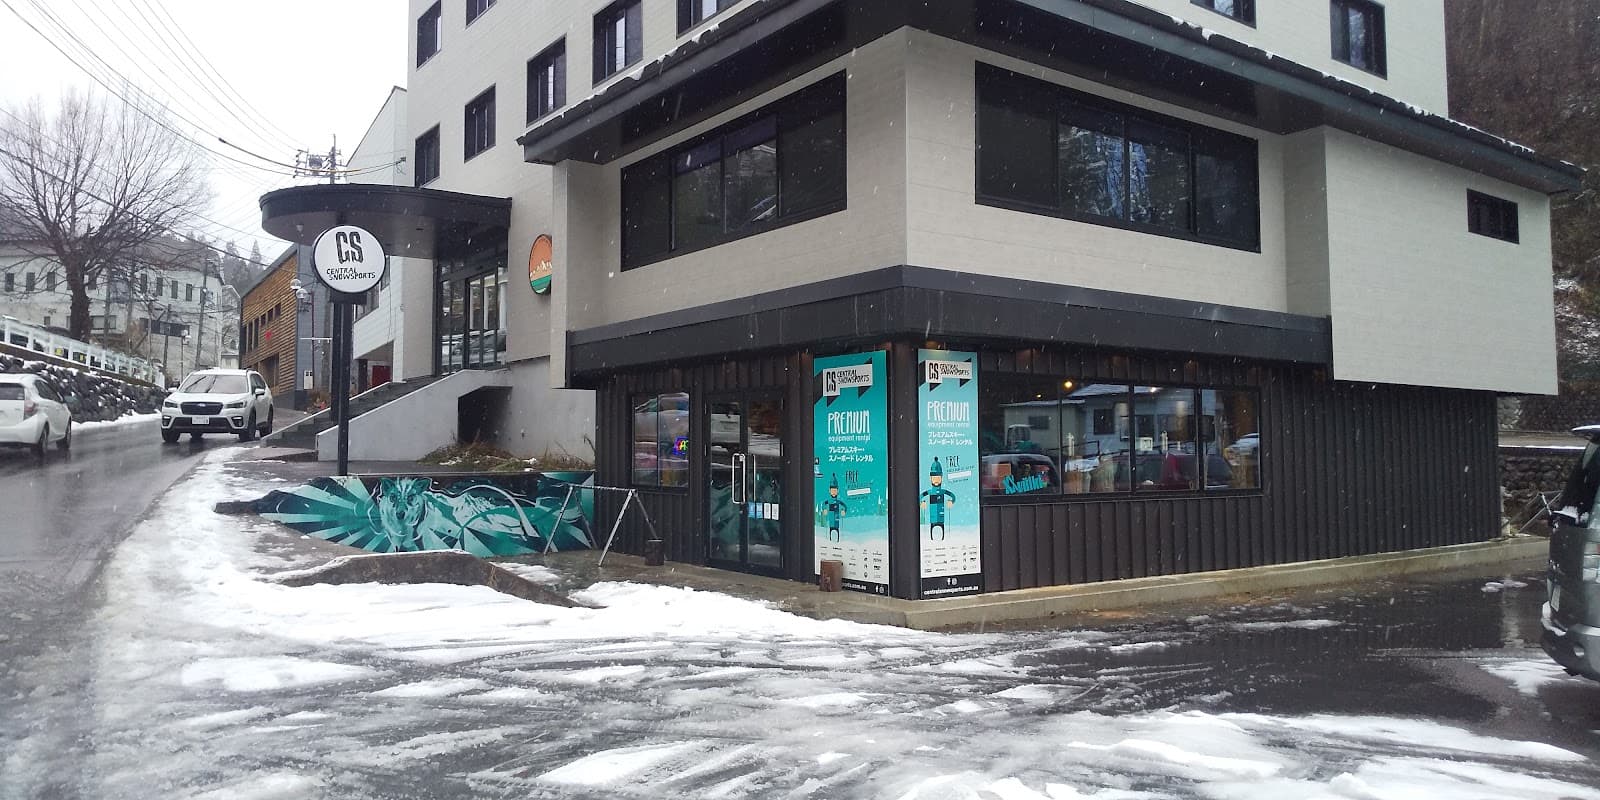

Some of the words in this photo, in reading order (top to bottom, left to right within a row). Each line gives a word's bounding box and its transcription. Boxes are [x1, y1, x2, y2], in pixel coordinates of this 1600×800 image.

[336, 232, 363, 264] CS
[329, 272, 376, 280] SNOWSPORTS
[929, 362, 939, 380] CS
[940, 363, 959, 371] CENTRAL
[940, 367, 970, 376] SNOWSPORTS
[837, 369, 857, 378] CENTRAL
[838, 374, 870, 384] SNOWSPORTS
[826, 371, 836, 392] CS
[927, 401, 970, 421] PREMIUM
[828, 410, 870, 434] PREMIUM
[828, 435, 854, 443] equipment
[946, 455, 960, 468] FREE
